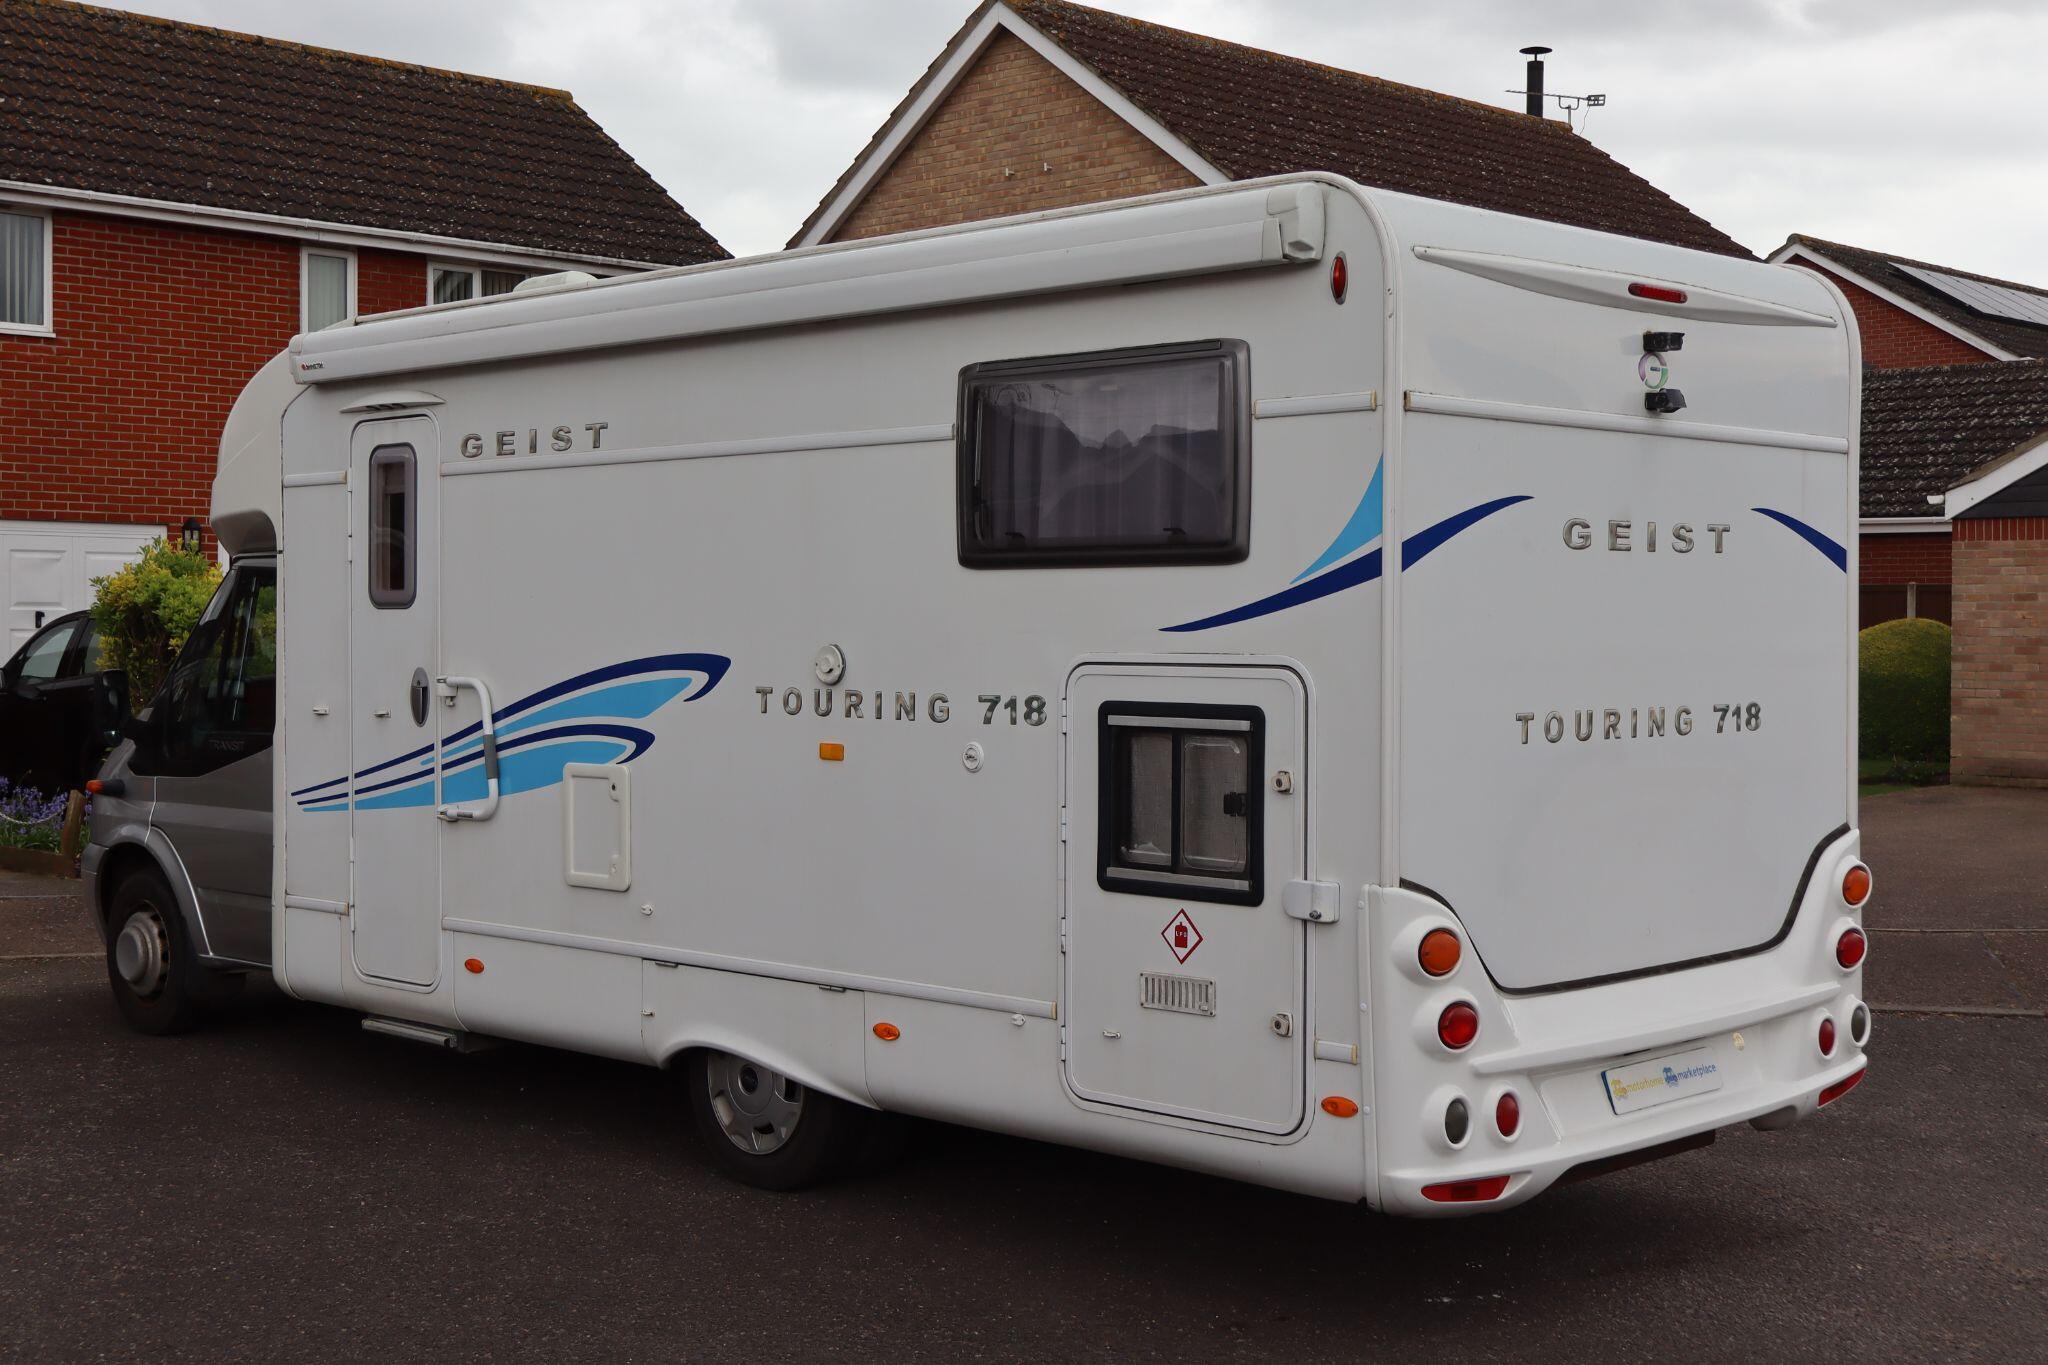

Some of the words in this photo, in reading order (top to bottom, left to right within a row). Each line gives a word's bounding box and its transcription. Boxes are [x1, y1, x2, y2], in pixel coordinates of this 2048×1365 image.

[461, 422, 609, 458] GEIST
[1562, 517, 1731, 554] GEIST
[755, 686, 950, 723] TOURING
[977, 694, 1048, 726] 718
[1515, 705, 1693, 744] TOURING
[1712, 701, 1762, 734] 718
[1677, 1063, 1717, 1080] marketplace
